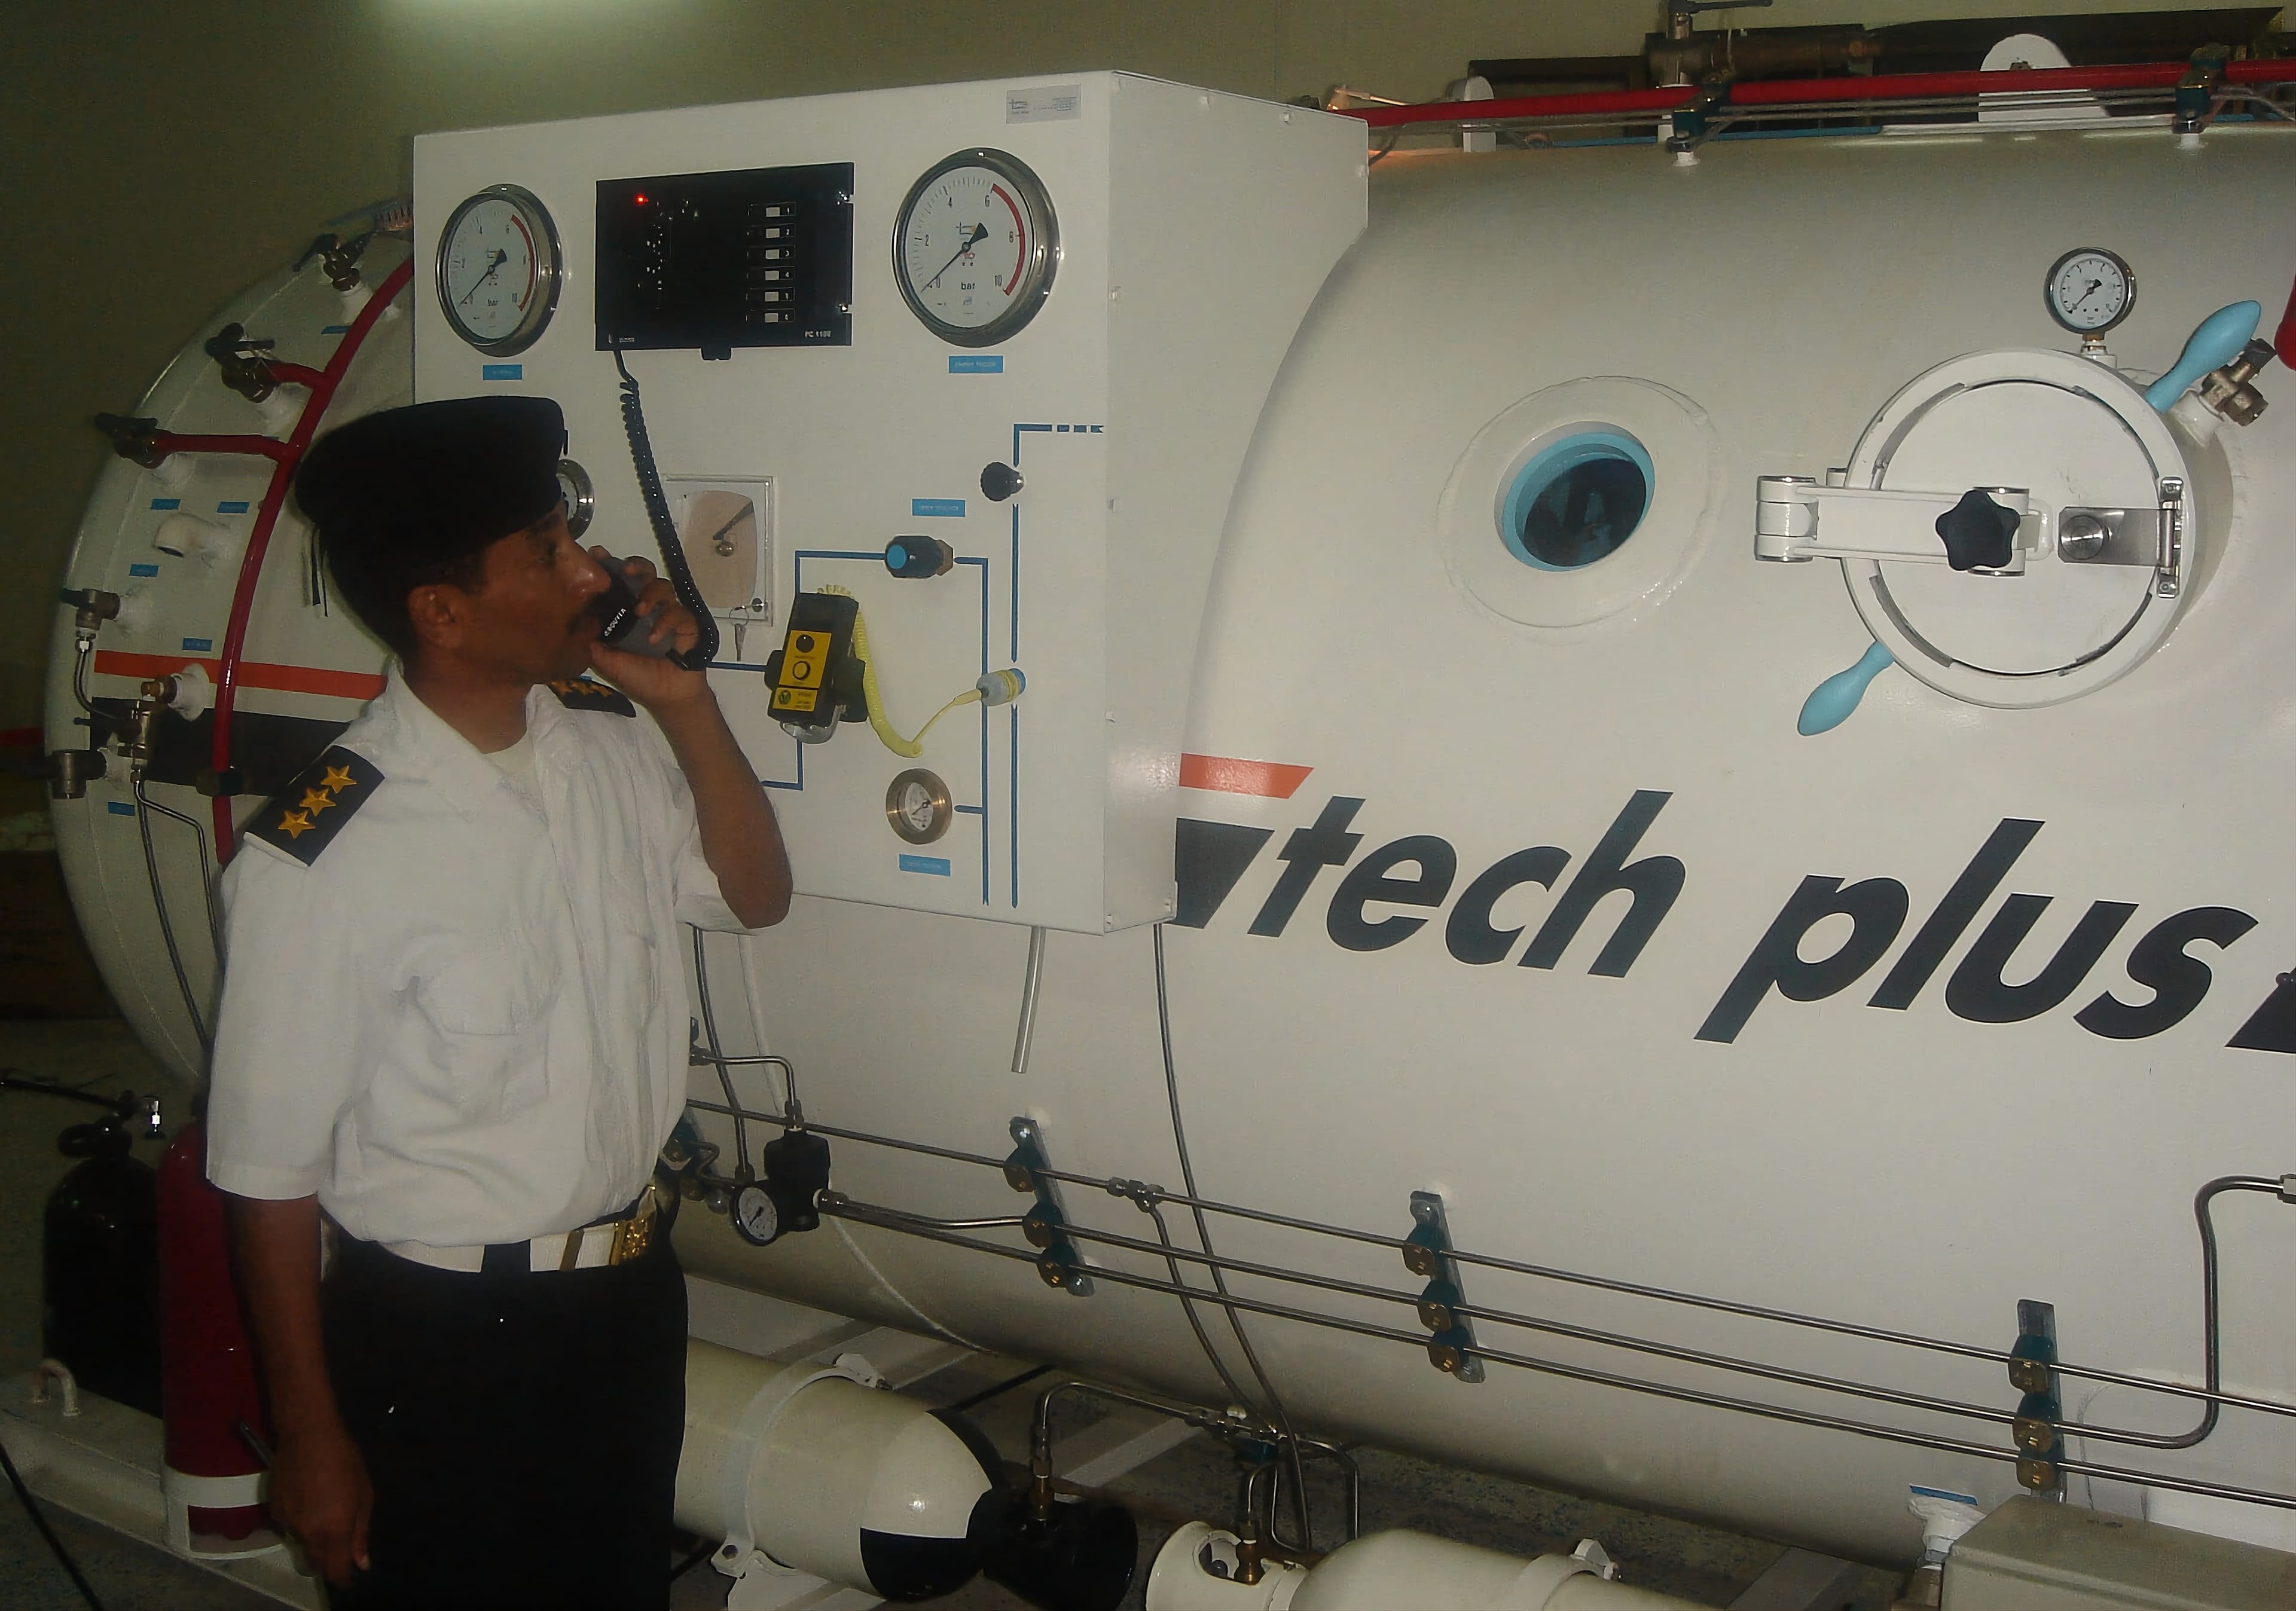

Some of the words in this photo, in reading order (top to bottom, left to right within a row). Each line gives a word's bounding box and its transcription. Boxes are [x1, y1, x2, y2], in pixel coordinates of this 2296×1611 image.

[985, 195, 990, 207] 6
[925, 234, 930, 246] 2
[1009, 231, 1014, 243] 8
[994, 274, 1002, 287] 10
[1247, 790, 1686, 979] tech
[1694, 818, 2260, 1044] plus
